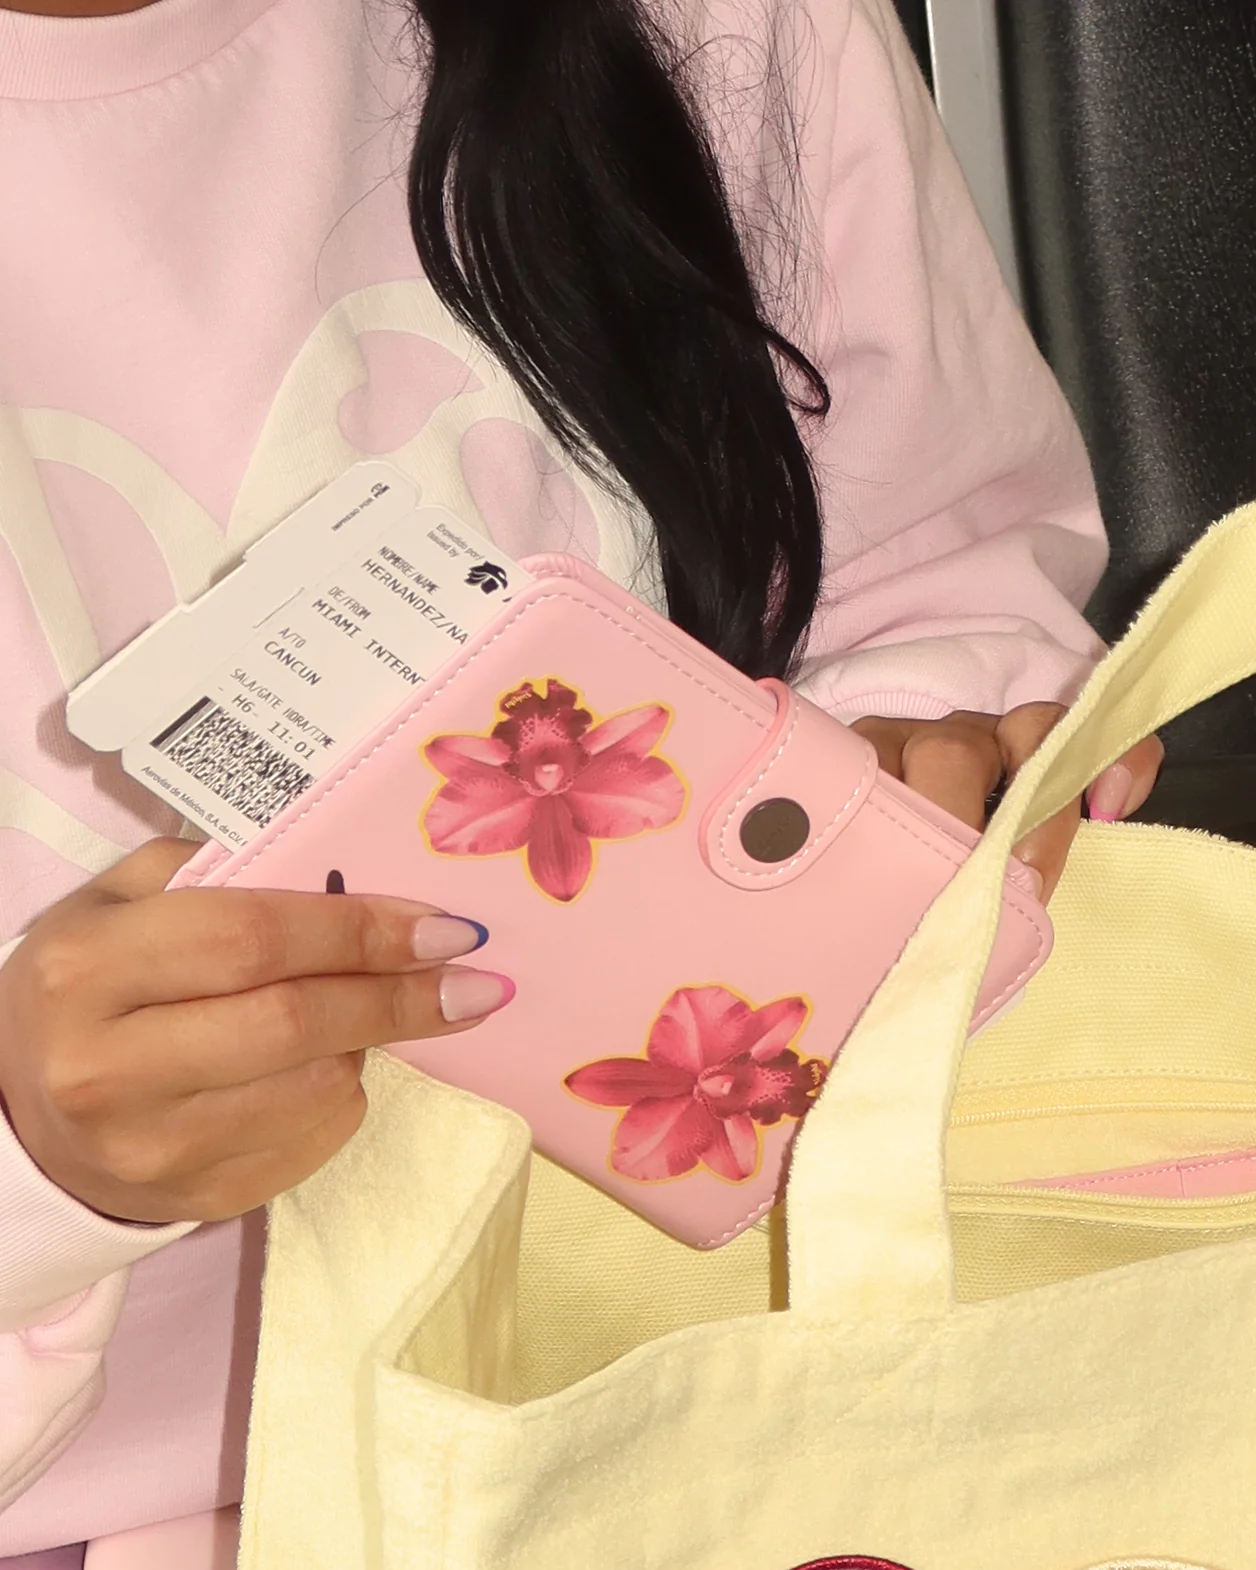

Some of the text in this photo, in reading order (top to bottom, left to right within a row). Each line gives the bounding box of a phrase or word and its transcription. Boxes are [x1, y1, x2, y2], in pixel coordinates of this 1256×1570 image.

[378, 546, 441, 595] NOMBRE/NAME
[312, 599, 362, 639] MIAMI
[328, 586, 372, 621] DE/FROM
[361, 559, 469, 645] HERNANDEZ/NA
[278, 627, 307, 649] A/TO
[264, 640, 322, 686] CANCUN
[230, 668, 284, 709] SALA/GATE
[170, 785, 181, 797] de
